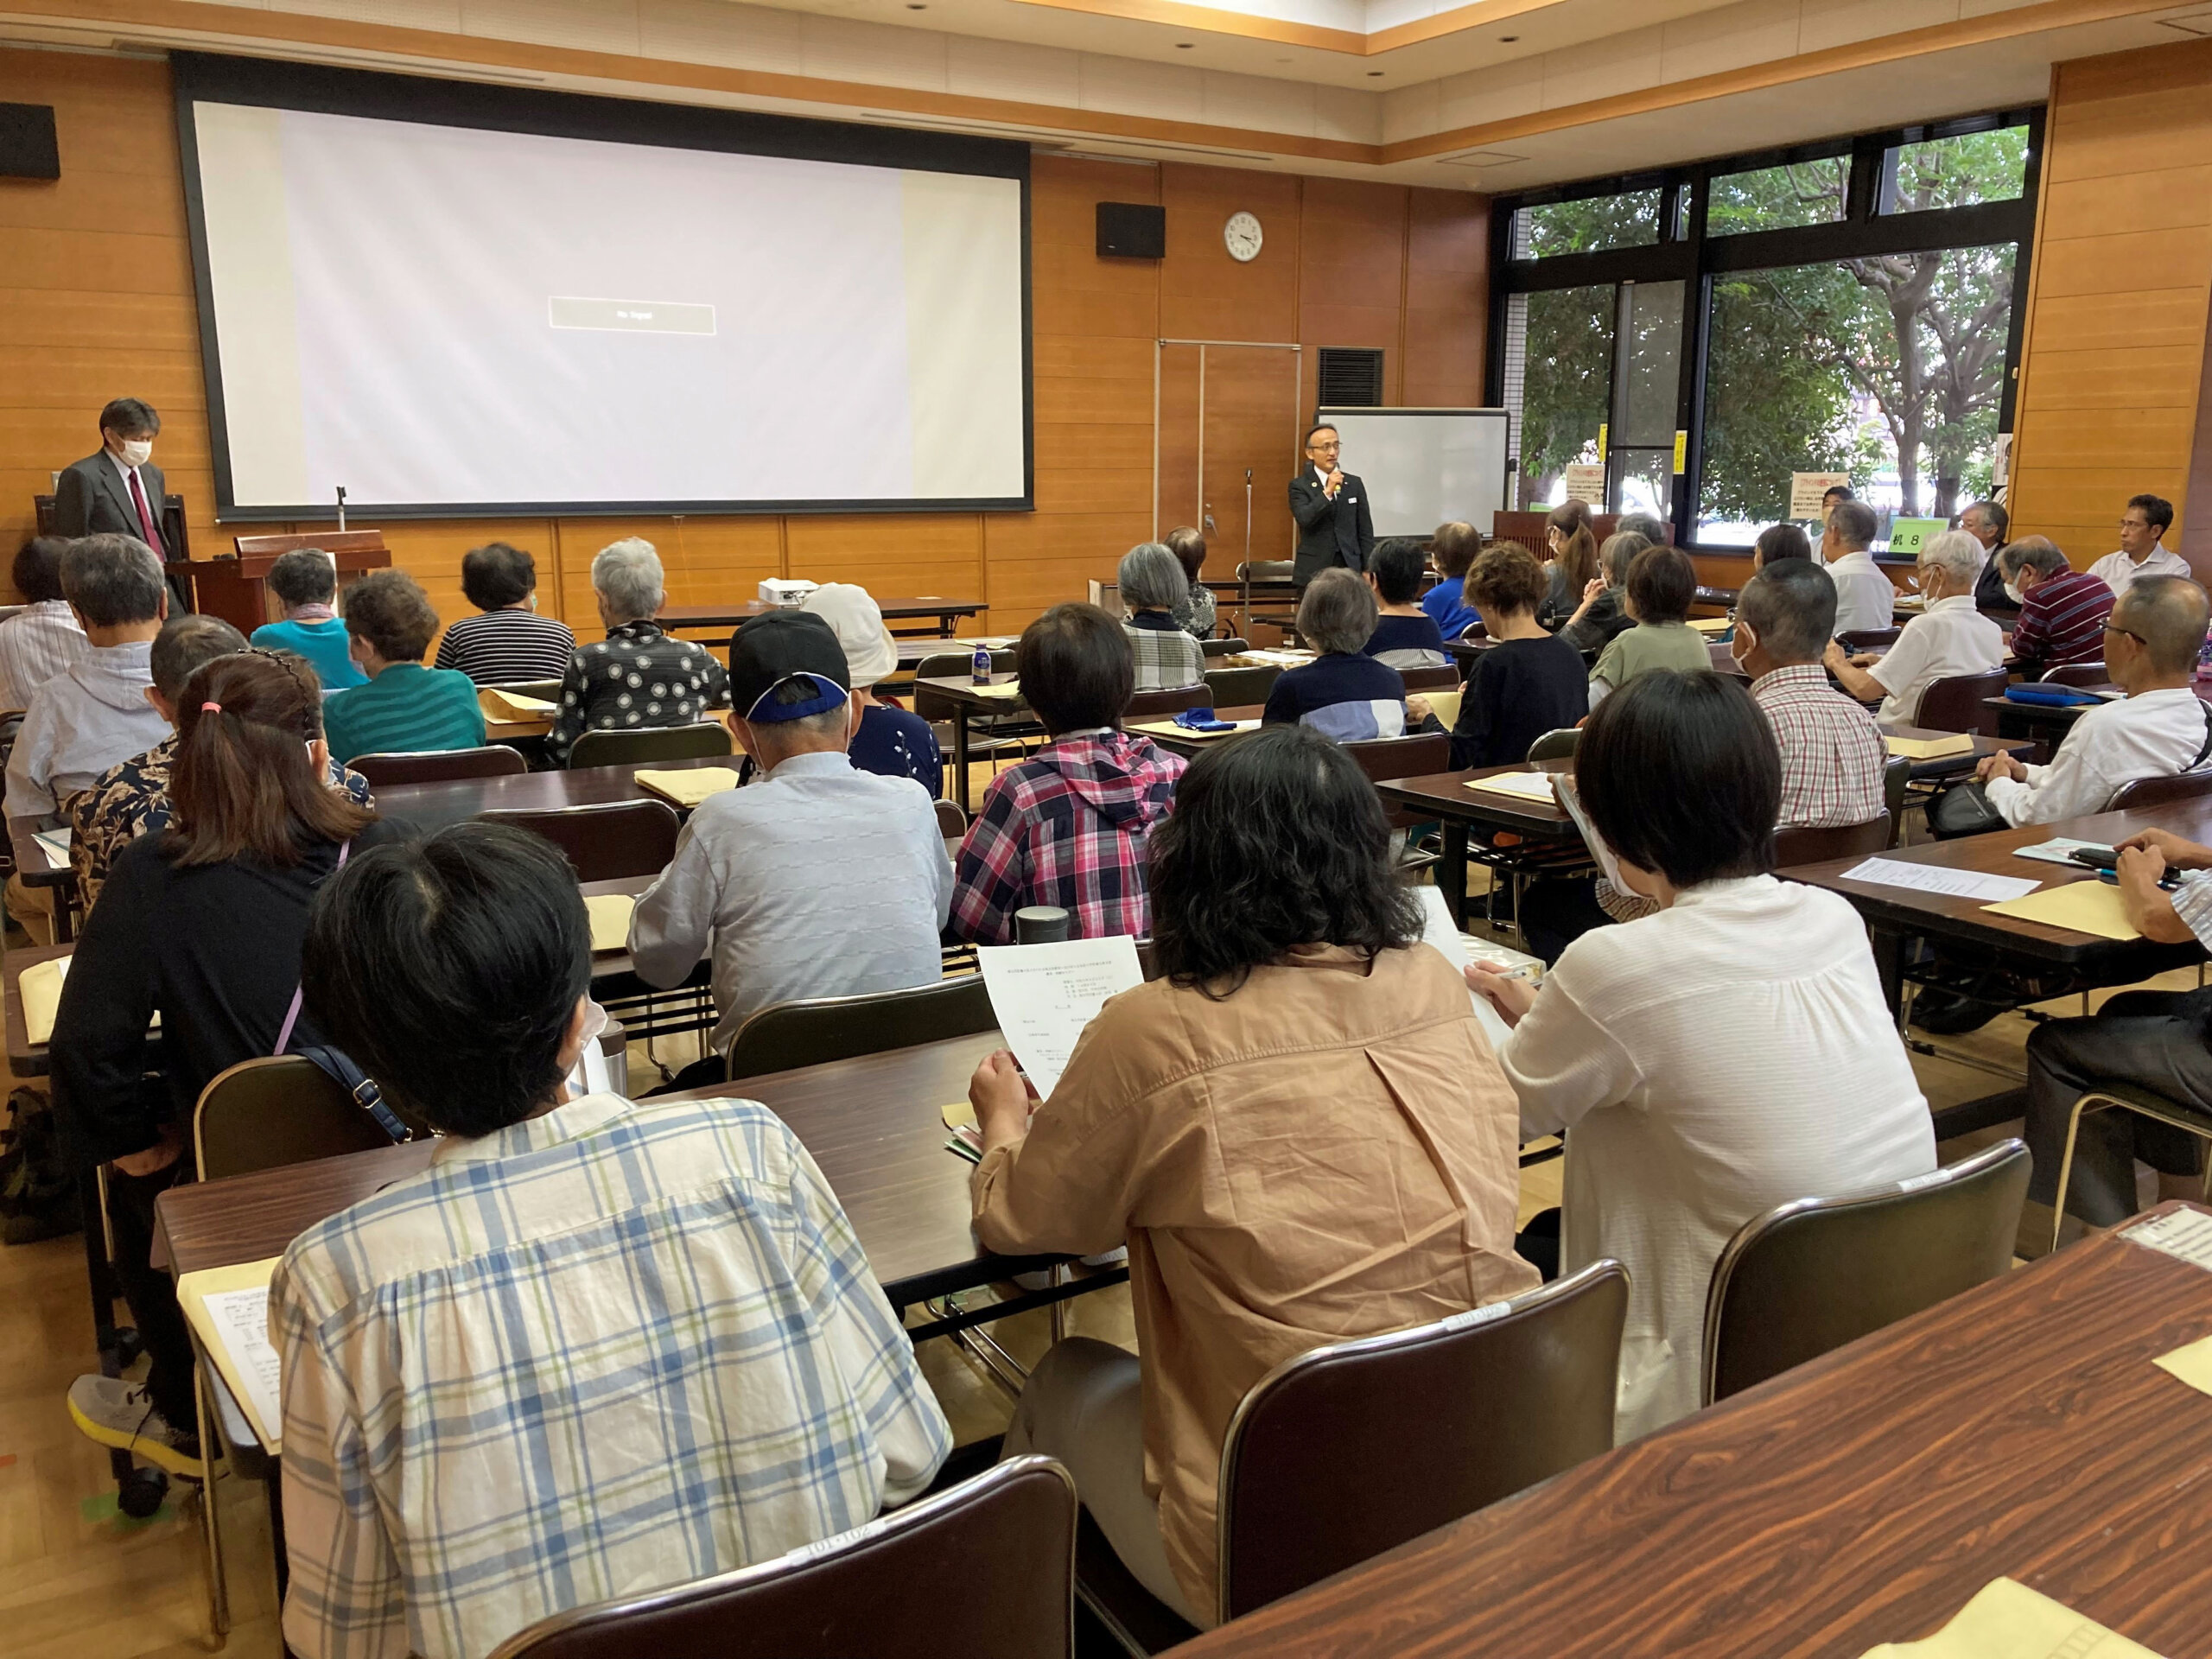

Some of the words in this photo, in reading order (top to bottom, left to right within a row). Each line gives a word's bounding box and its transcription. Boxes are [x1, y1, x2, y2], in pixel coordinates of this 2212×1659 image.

[616, 310, 628, 319] No
[629, 311, 652, 321] Signal
[1892, 534, 1903, 546] 机
[1910, 534, 1919, 546] 8
